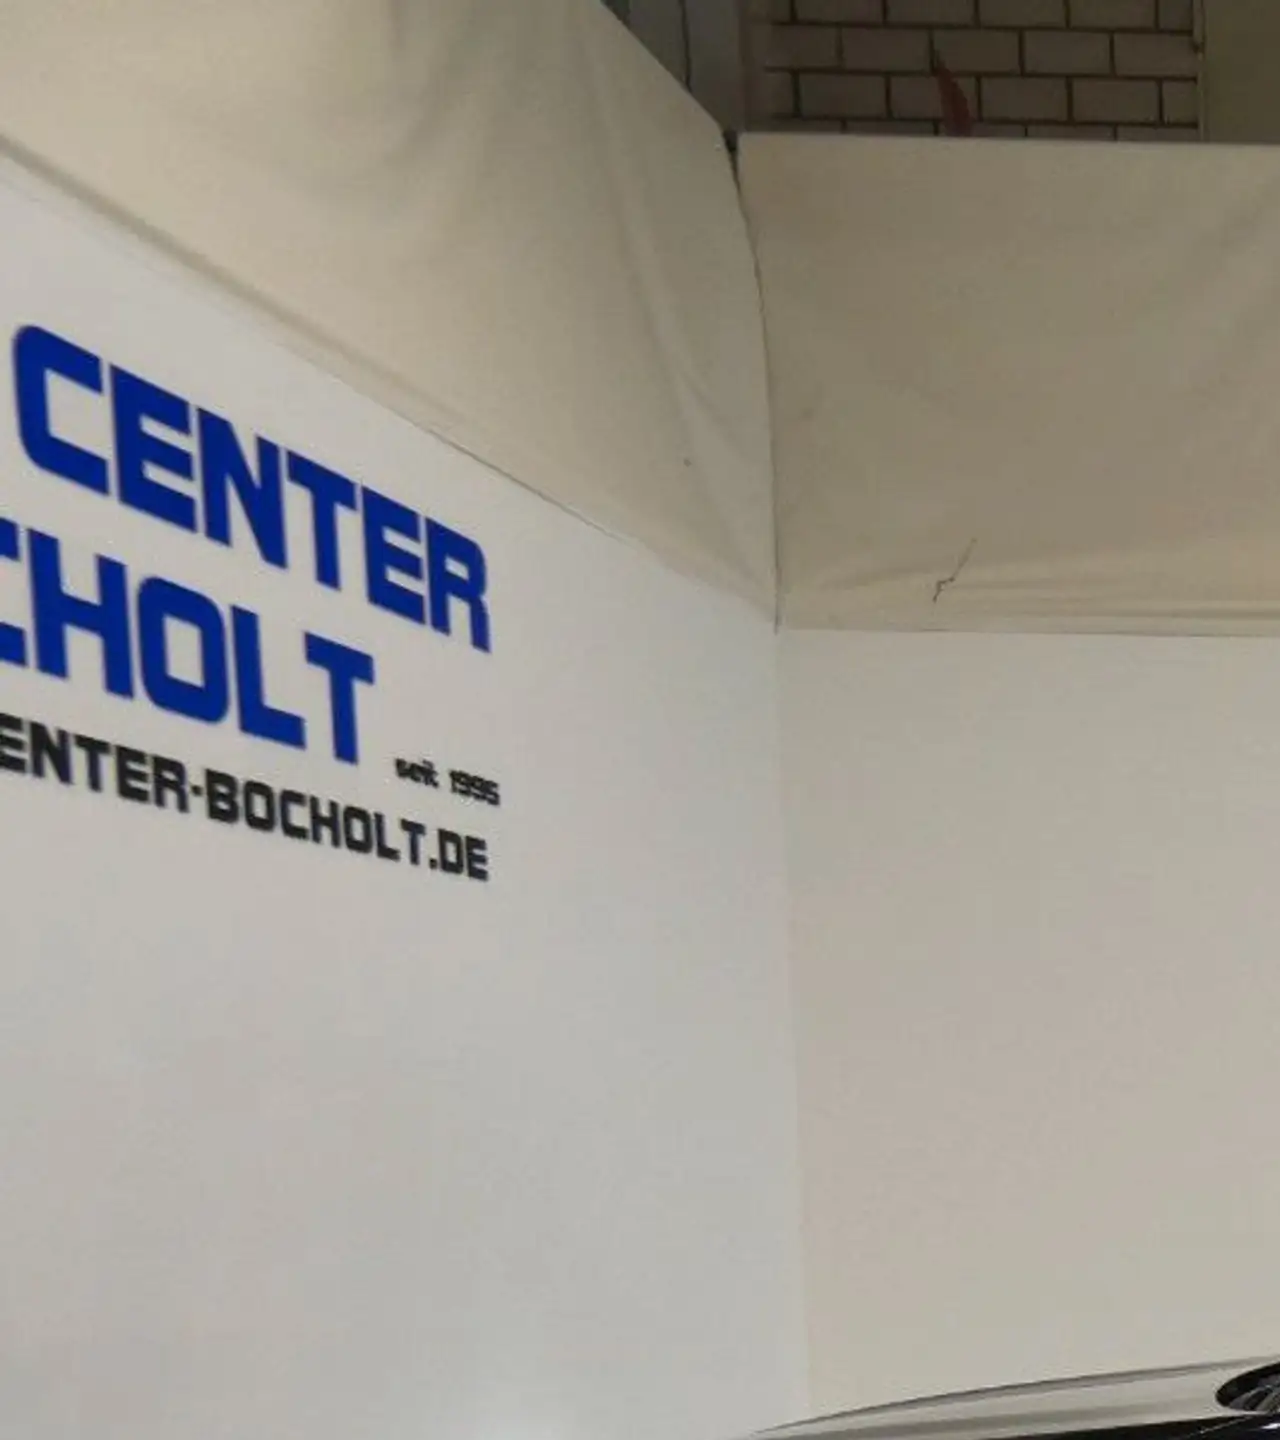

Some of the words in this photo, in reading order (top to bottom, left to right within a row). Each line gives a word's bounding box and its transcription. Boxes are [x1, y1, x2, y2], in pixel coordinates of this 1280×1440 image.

[13, 325, 491, 653] CENTER
[0, 517, 375, 765] HOLT
[394, 758, 440, 788] seit
[448, 769, 501, 806] 1995
